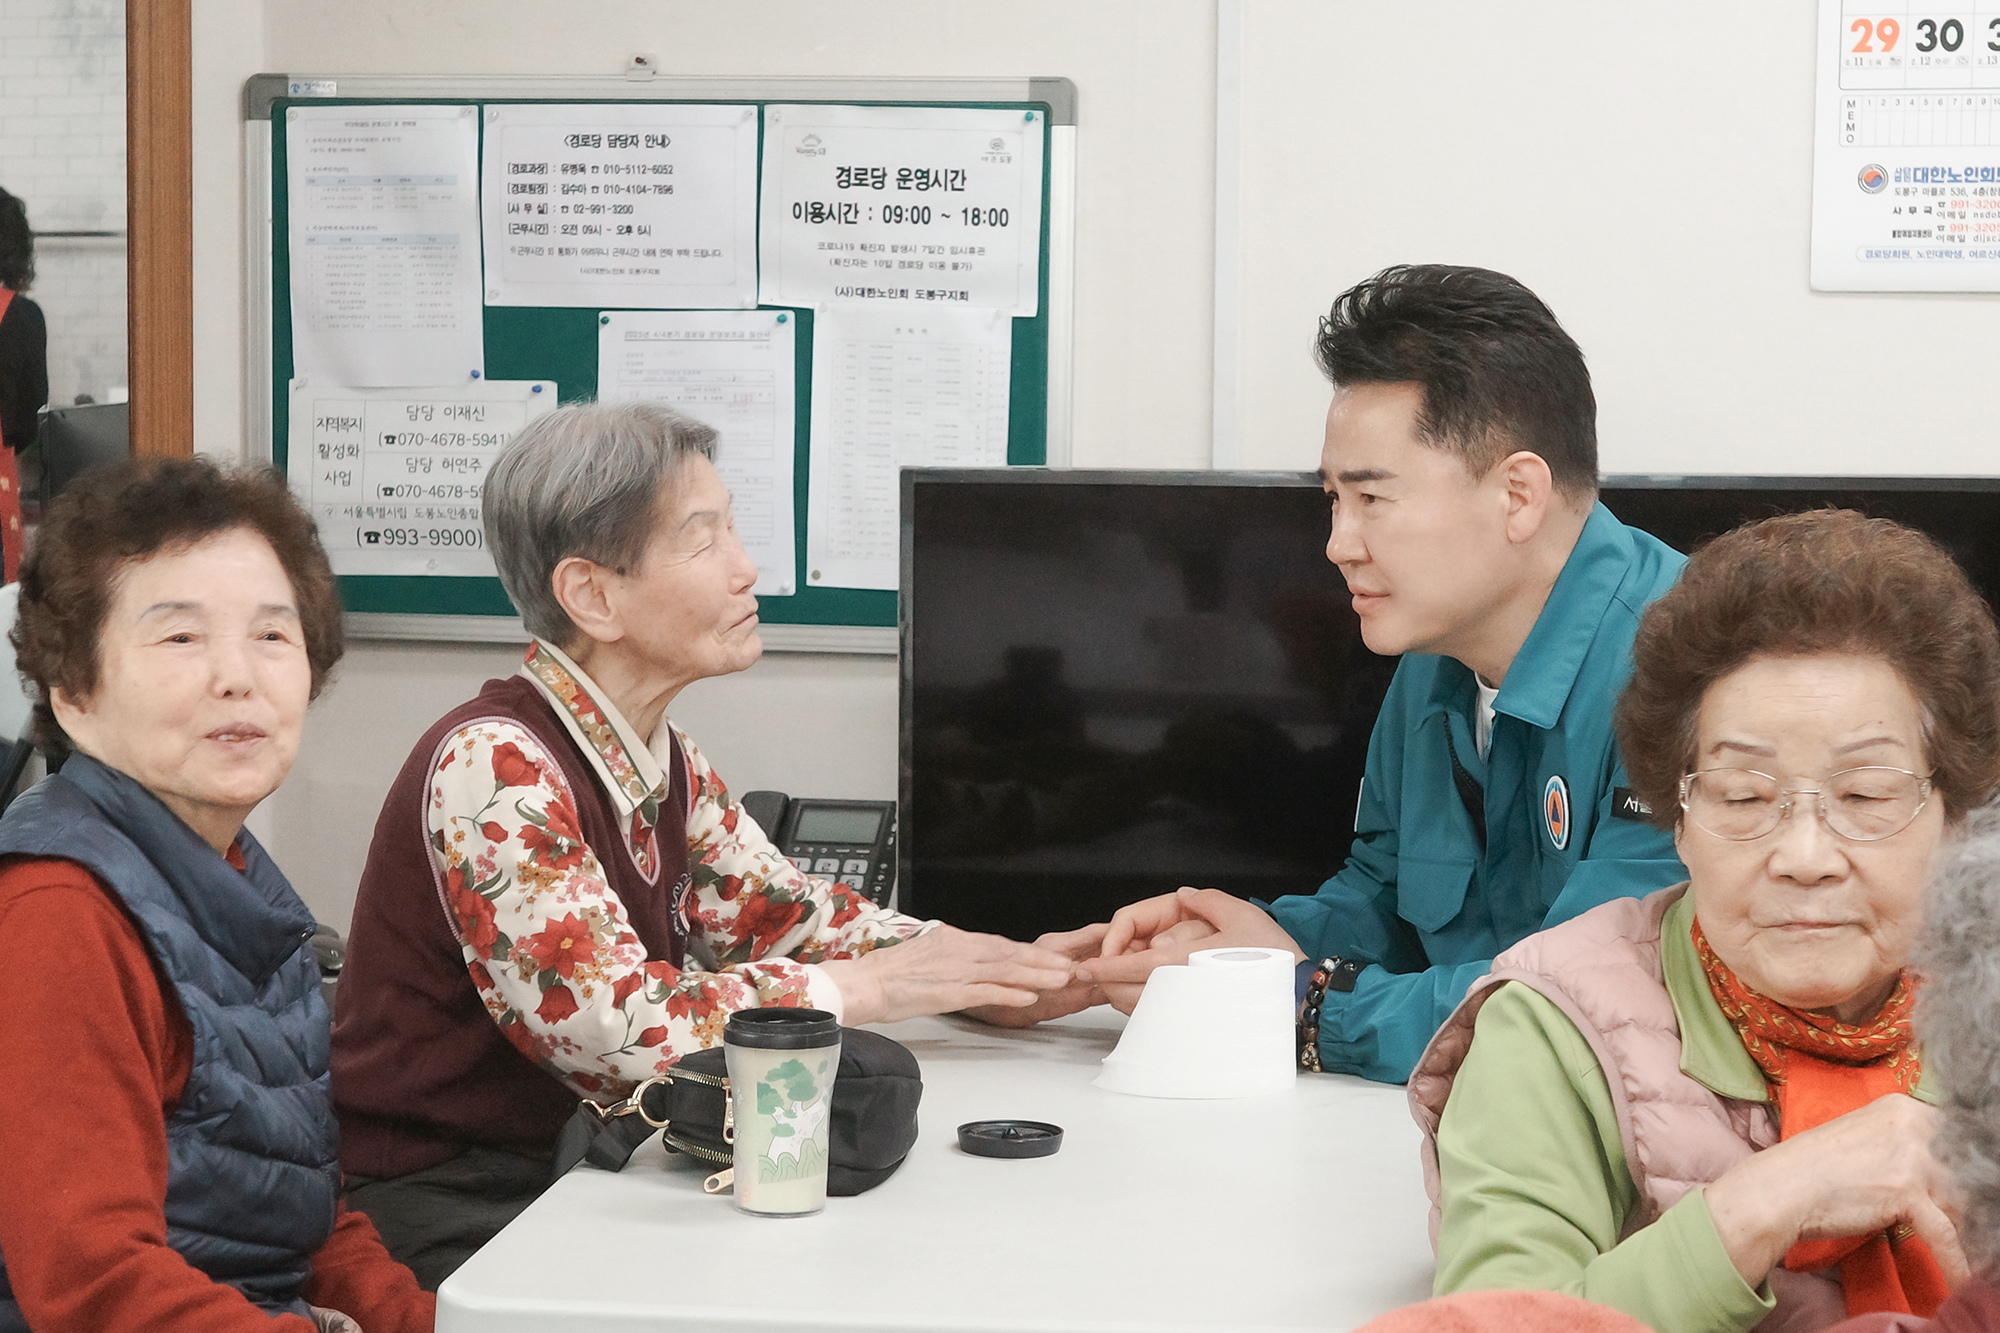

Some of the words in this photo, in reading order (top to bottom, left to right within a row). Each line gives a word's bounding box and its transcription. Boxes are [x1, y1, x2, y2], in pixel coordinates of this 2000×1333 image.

[1851, 18, 1900, 53] 29
[1915, 19, 1964, 52] 30
[608, 134, 639, 148] 담당자
[603, 164, 673, 174] 010-5112-6052
[1913, 166, 2000, 183] 대한노인회
[835, 166, 887, 190] 경로당
[896, 167, 966, 192] 운영시간
[561, 183, 586, 195] 김수아
[573, 204, 634, 214] 02-991-3200
[793, 200, 860, 225] 이용시간
[882, 205, 931, 225] 09:00
[962, 207, 1009, 227] 18:00
[561, 224, 578, 235] 오전
[582, 224, 602, 236] 09시
[616, 224, 633, 235] 오후
[860, 244, 885, 253] 확진자
[922, 245, 945, 255] 7일간
[874, 259, 893, 269] 10일
[929, 261, 946, 270] 이용
[835, 286, 909, 299] (사)대한노인회
[915, 289, 969, 301] 도봉구지회
[406, 404, 434, 421] 담당
[443, 404, 485, 422] 이재신
[316, 416, 362, 433] 지역복지
[406, 457, 432, 473] 담당
[442, 457, 482, 473] 허연주
[324, 470, 351, 487] 사업
[343, 506, 407, 519] 서울특별시립
[414, 507, 482, 520] 도봉노인종합
